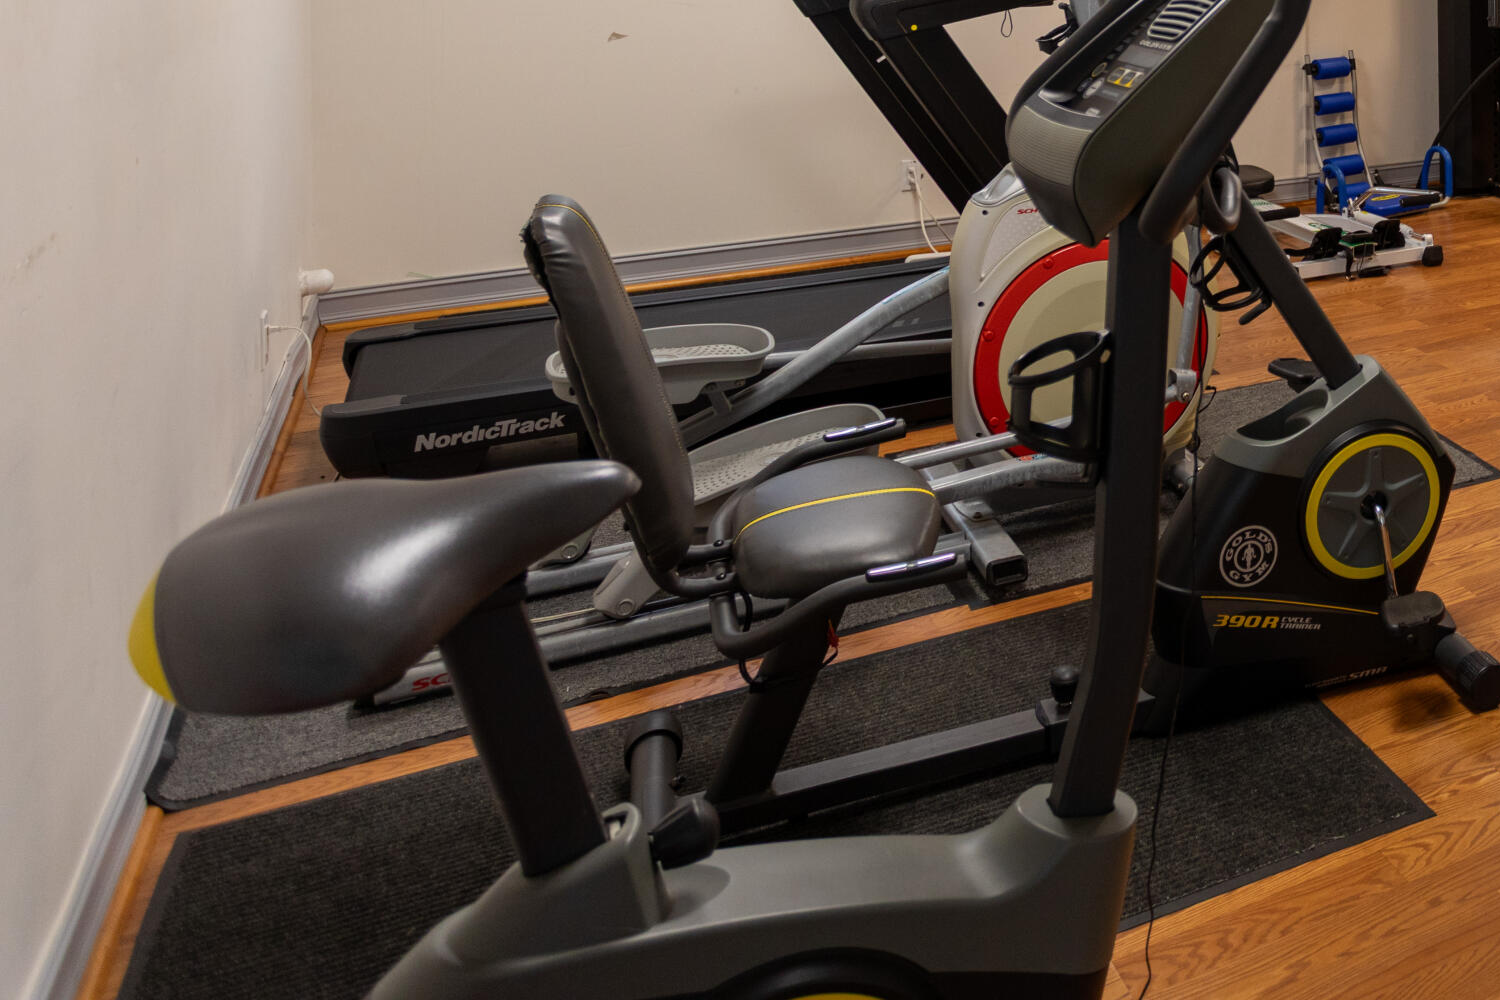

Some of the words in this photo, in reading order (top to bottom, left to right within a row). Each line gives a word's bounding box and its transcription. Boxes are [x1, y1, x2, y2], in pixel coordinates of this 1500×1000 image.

[414, 411, 567, 453] NordicTrack
[1225, 531, 1273, 561] GOLD'S
[1229, 561, 1270, 582] GYM
[1212, 613, 1280, 629] 390R
